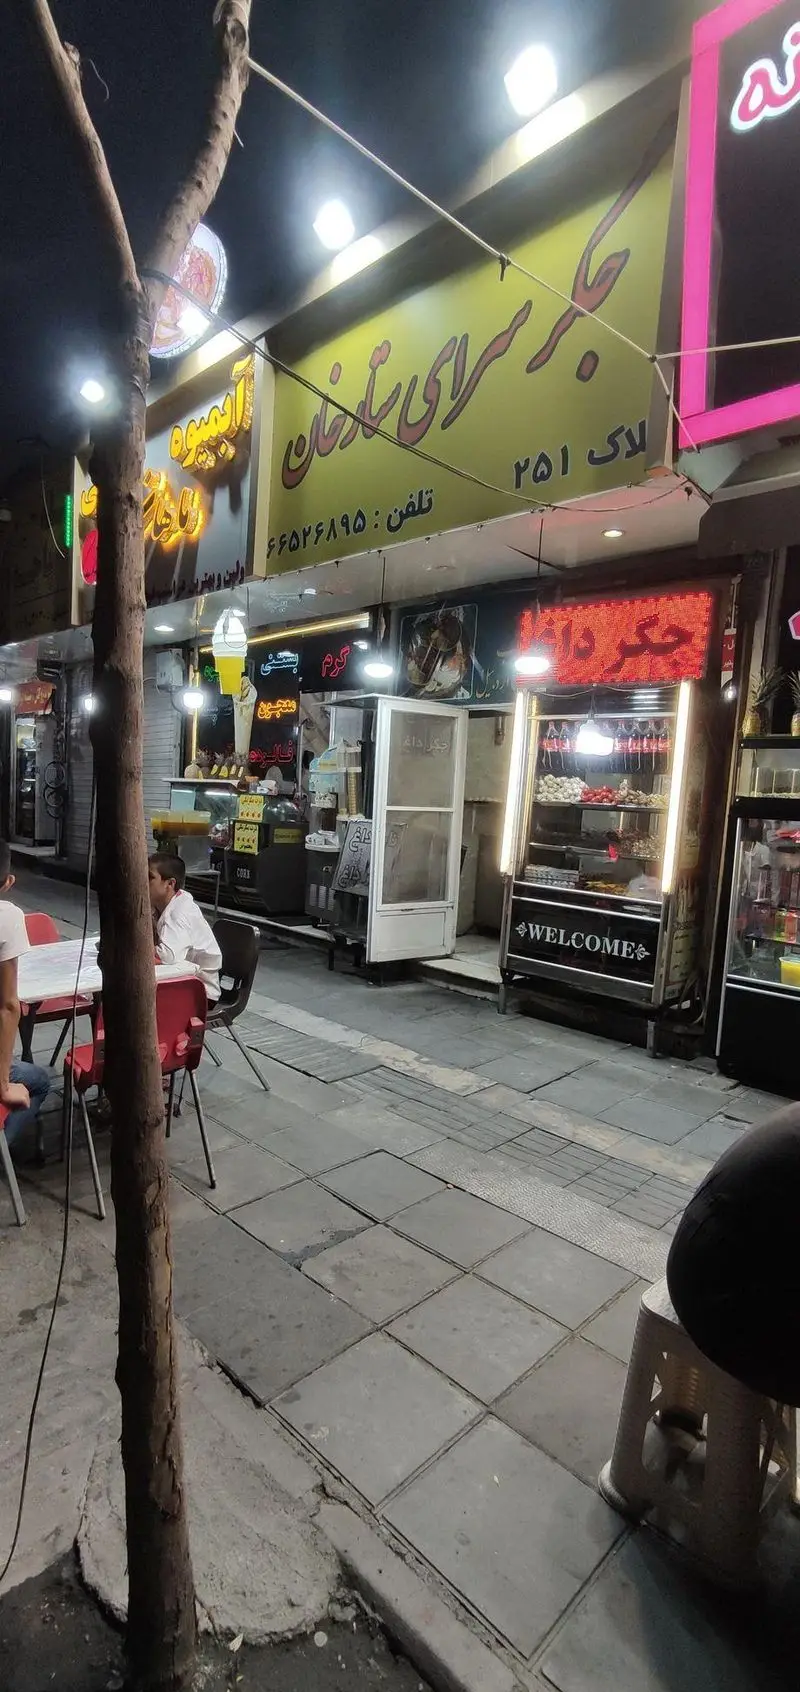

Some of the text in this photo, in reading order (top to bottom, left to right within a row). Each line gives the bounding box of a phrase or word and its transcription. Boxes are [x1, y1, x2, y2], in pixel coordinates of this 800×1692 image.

[397, 299, 533, 446] سرای
[169, 354, 255, 470] آبمیوه
[281, 340, 402, 490] ستارخان
[514, 444, 569, 490] ۲۵۱
[266, 508, 367, 559] ۶۶۵۲۶۸۹۵
[386, 489, 433, 533] تلفن
[260, 653, 299, 676] بستنی
[321, 644, 351, 678] گرم
[528, 923, 636, 959] WELCOME
